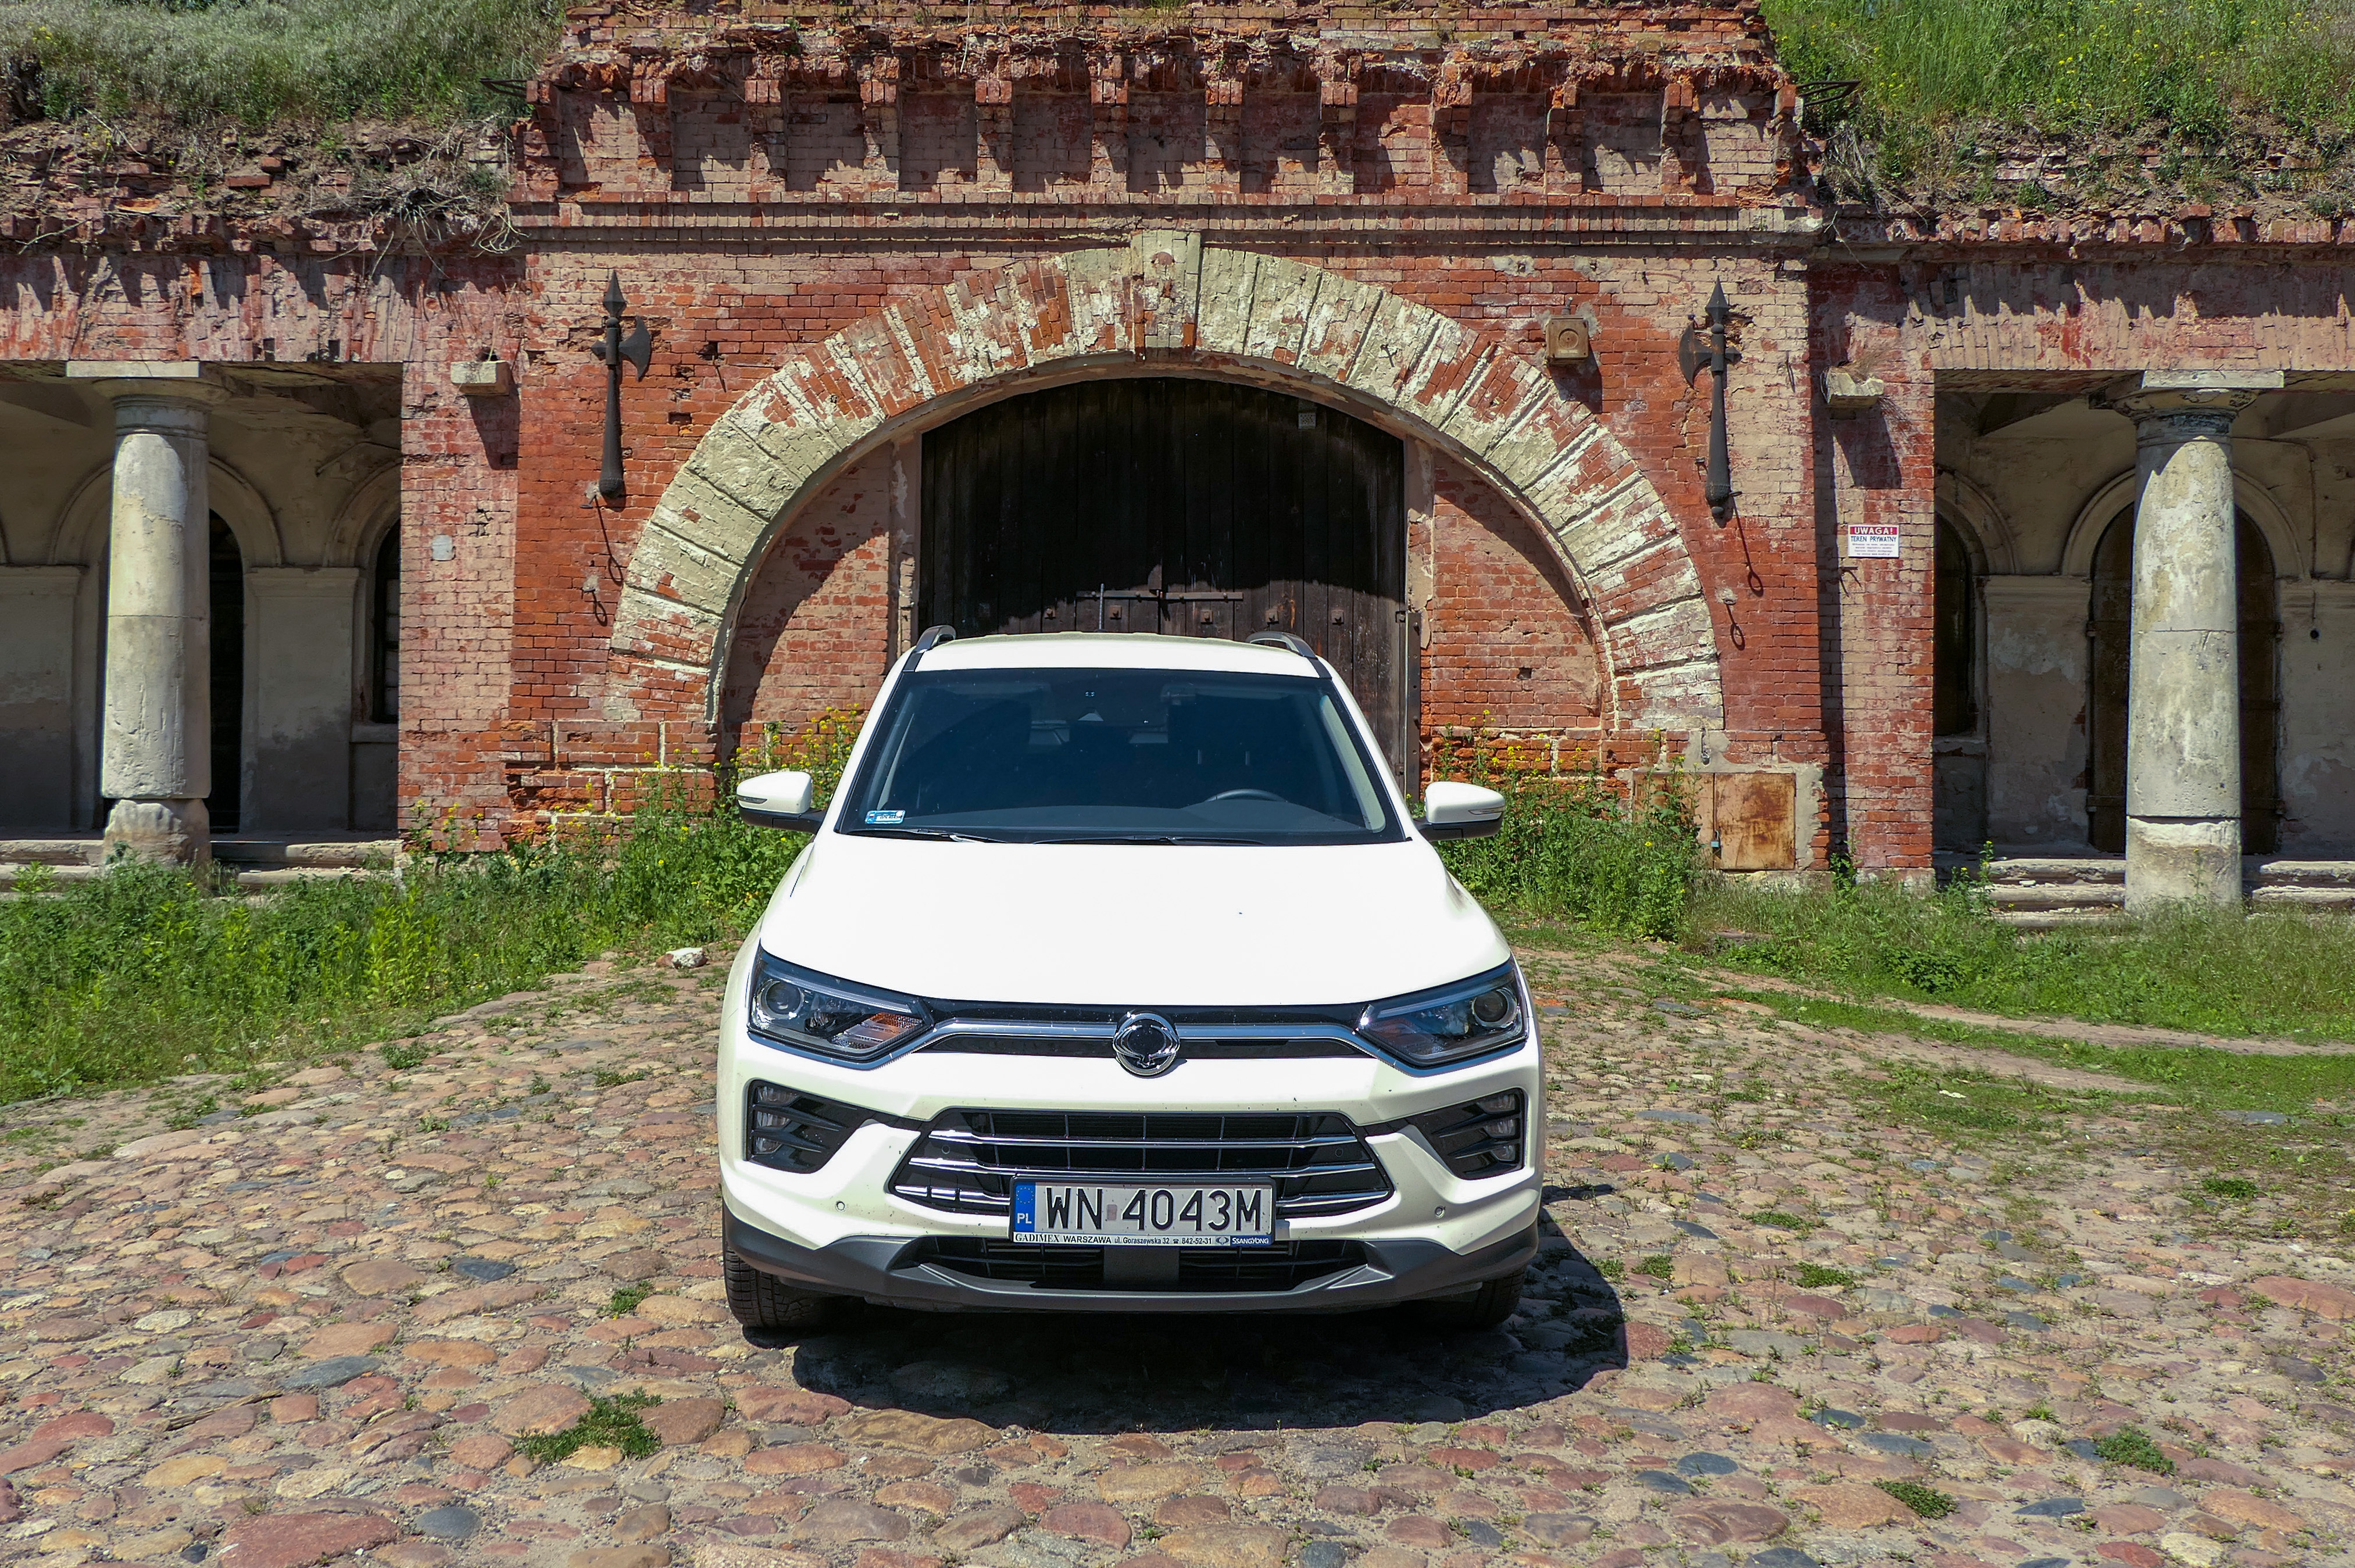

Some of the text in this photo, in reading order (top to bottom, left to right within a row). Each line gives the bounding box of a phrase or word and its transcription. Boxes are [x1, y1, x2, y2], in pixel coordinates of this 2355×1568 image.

[1854, 527, 1893, 535] UWAGA!
[1046, 1187, 1262, 1232] WN 4043M
[1017, 1213, 1032, 1224] PL
[1015, 1233, 1060, 1243] GADIMEX
[1063, 1235, 1112, 1244] WARSZAWA
